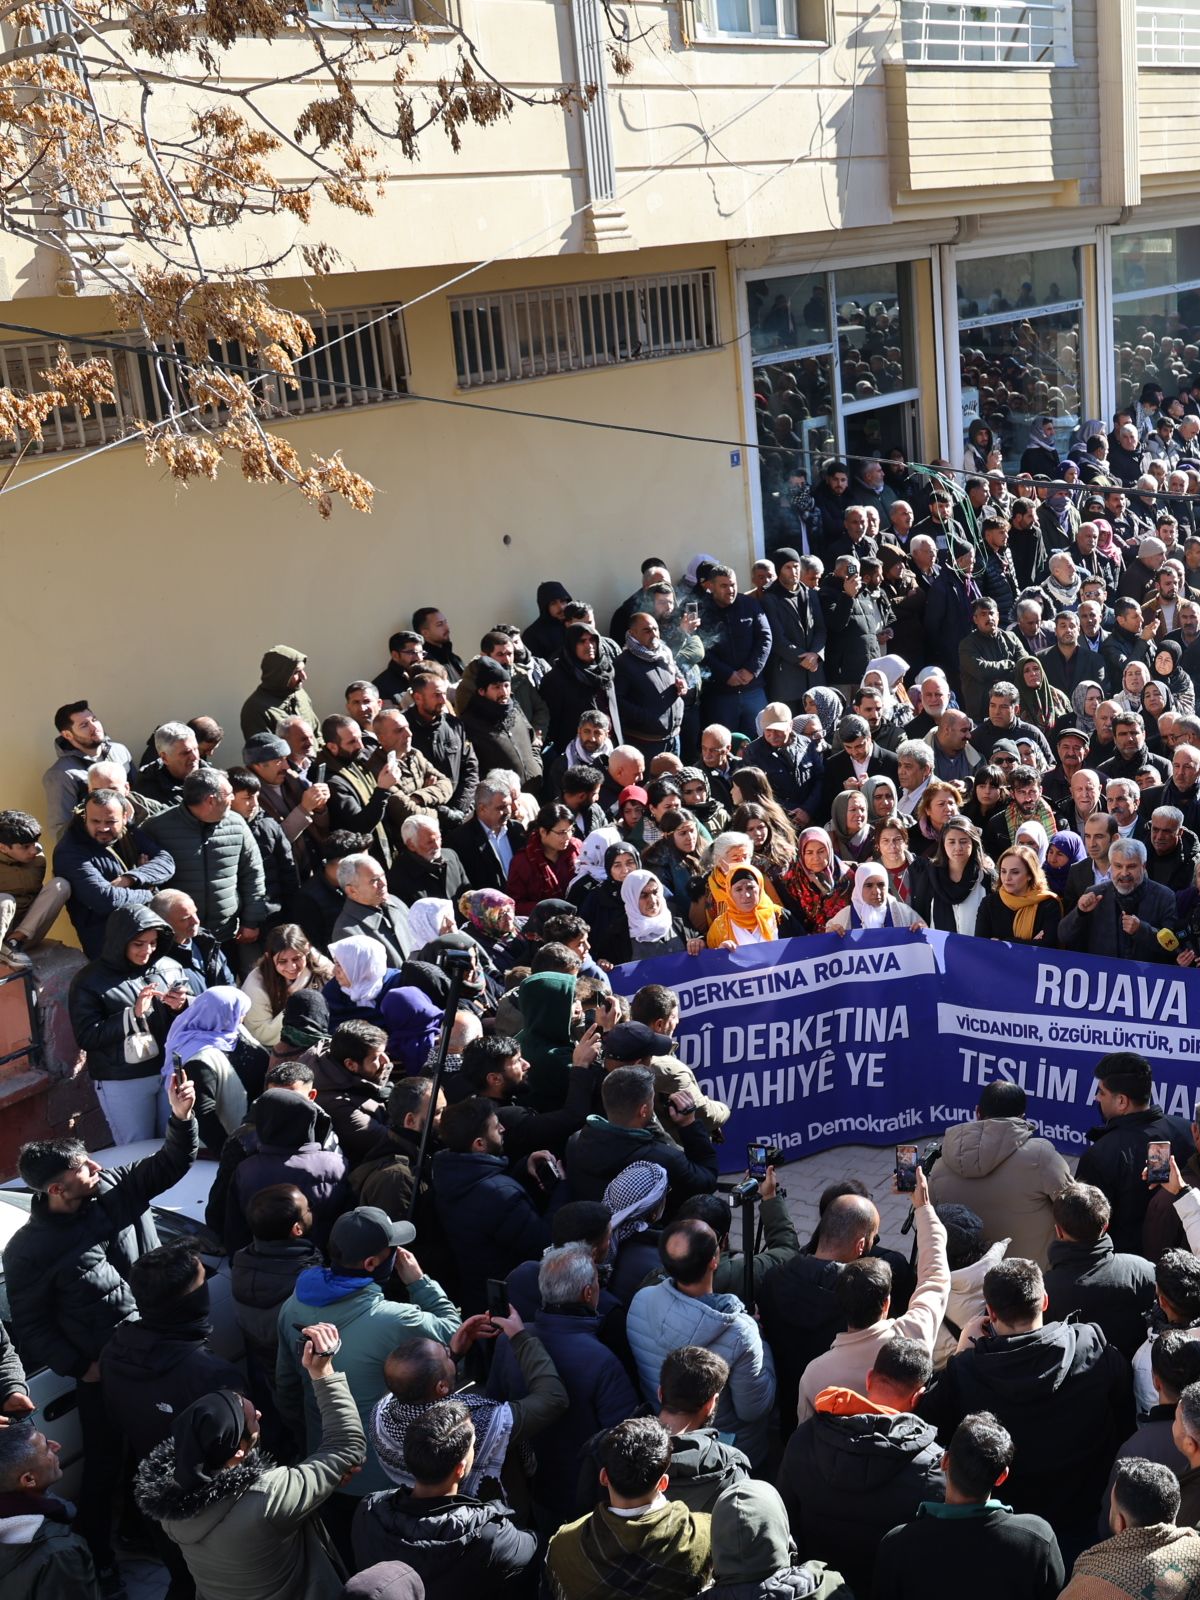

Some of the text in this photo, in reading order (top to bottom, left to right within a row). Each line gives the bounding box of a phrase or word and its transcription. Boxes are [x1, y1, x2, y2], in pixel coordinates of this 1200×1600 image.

[678, 952, 901, 1011] DERKETINA ROJAVA
[1035, 963, 1188, 1025] ROJAVA
[722, 1005, 910, 1064] DERKETINA
[956, 1015, 1043, 1043] VİCDANDIR,
[1048, 1022, 1173, 1055] ÖZGÜRLÜKTÜR,
[845, 1052, 887, 1088] YE
[959, 1047, 1078, 1103] TESLİM
[807, 1107, 924, 1142] Demokratik
